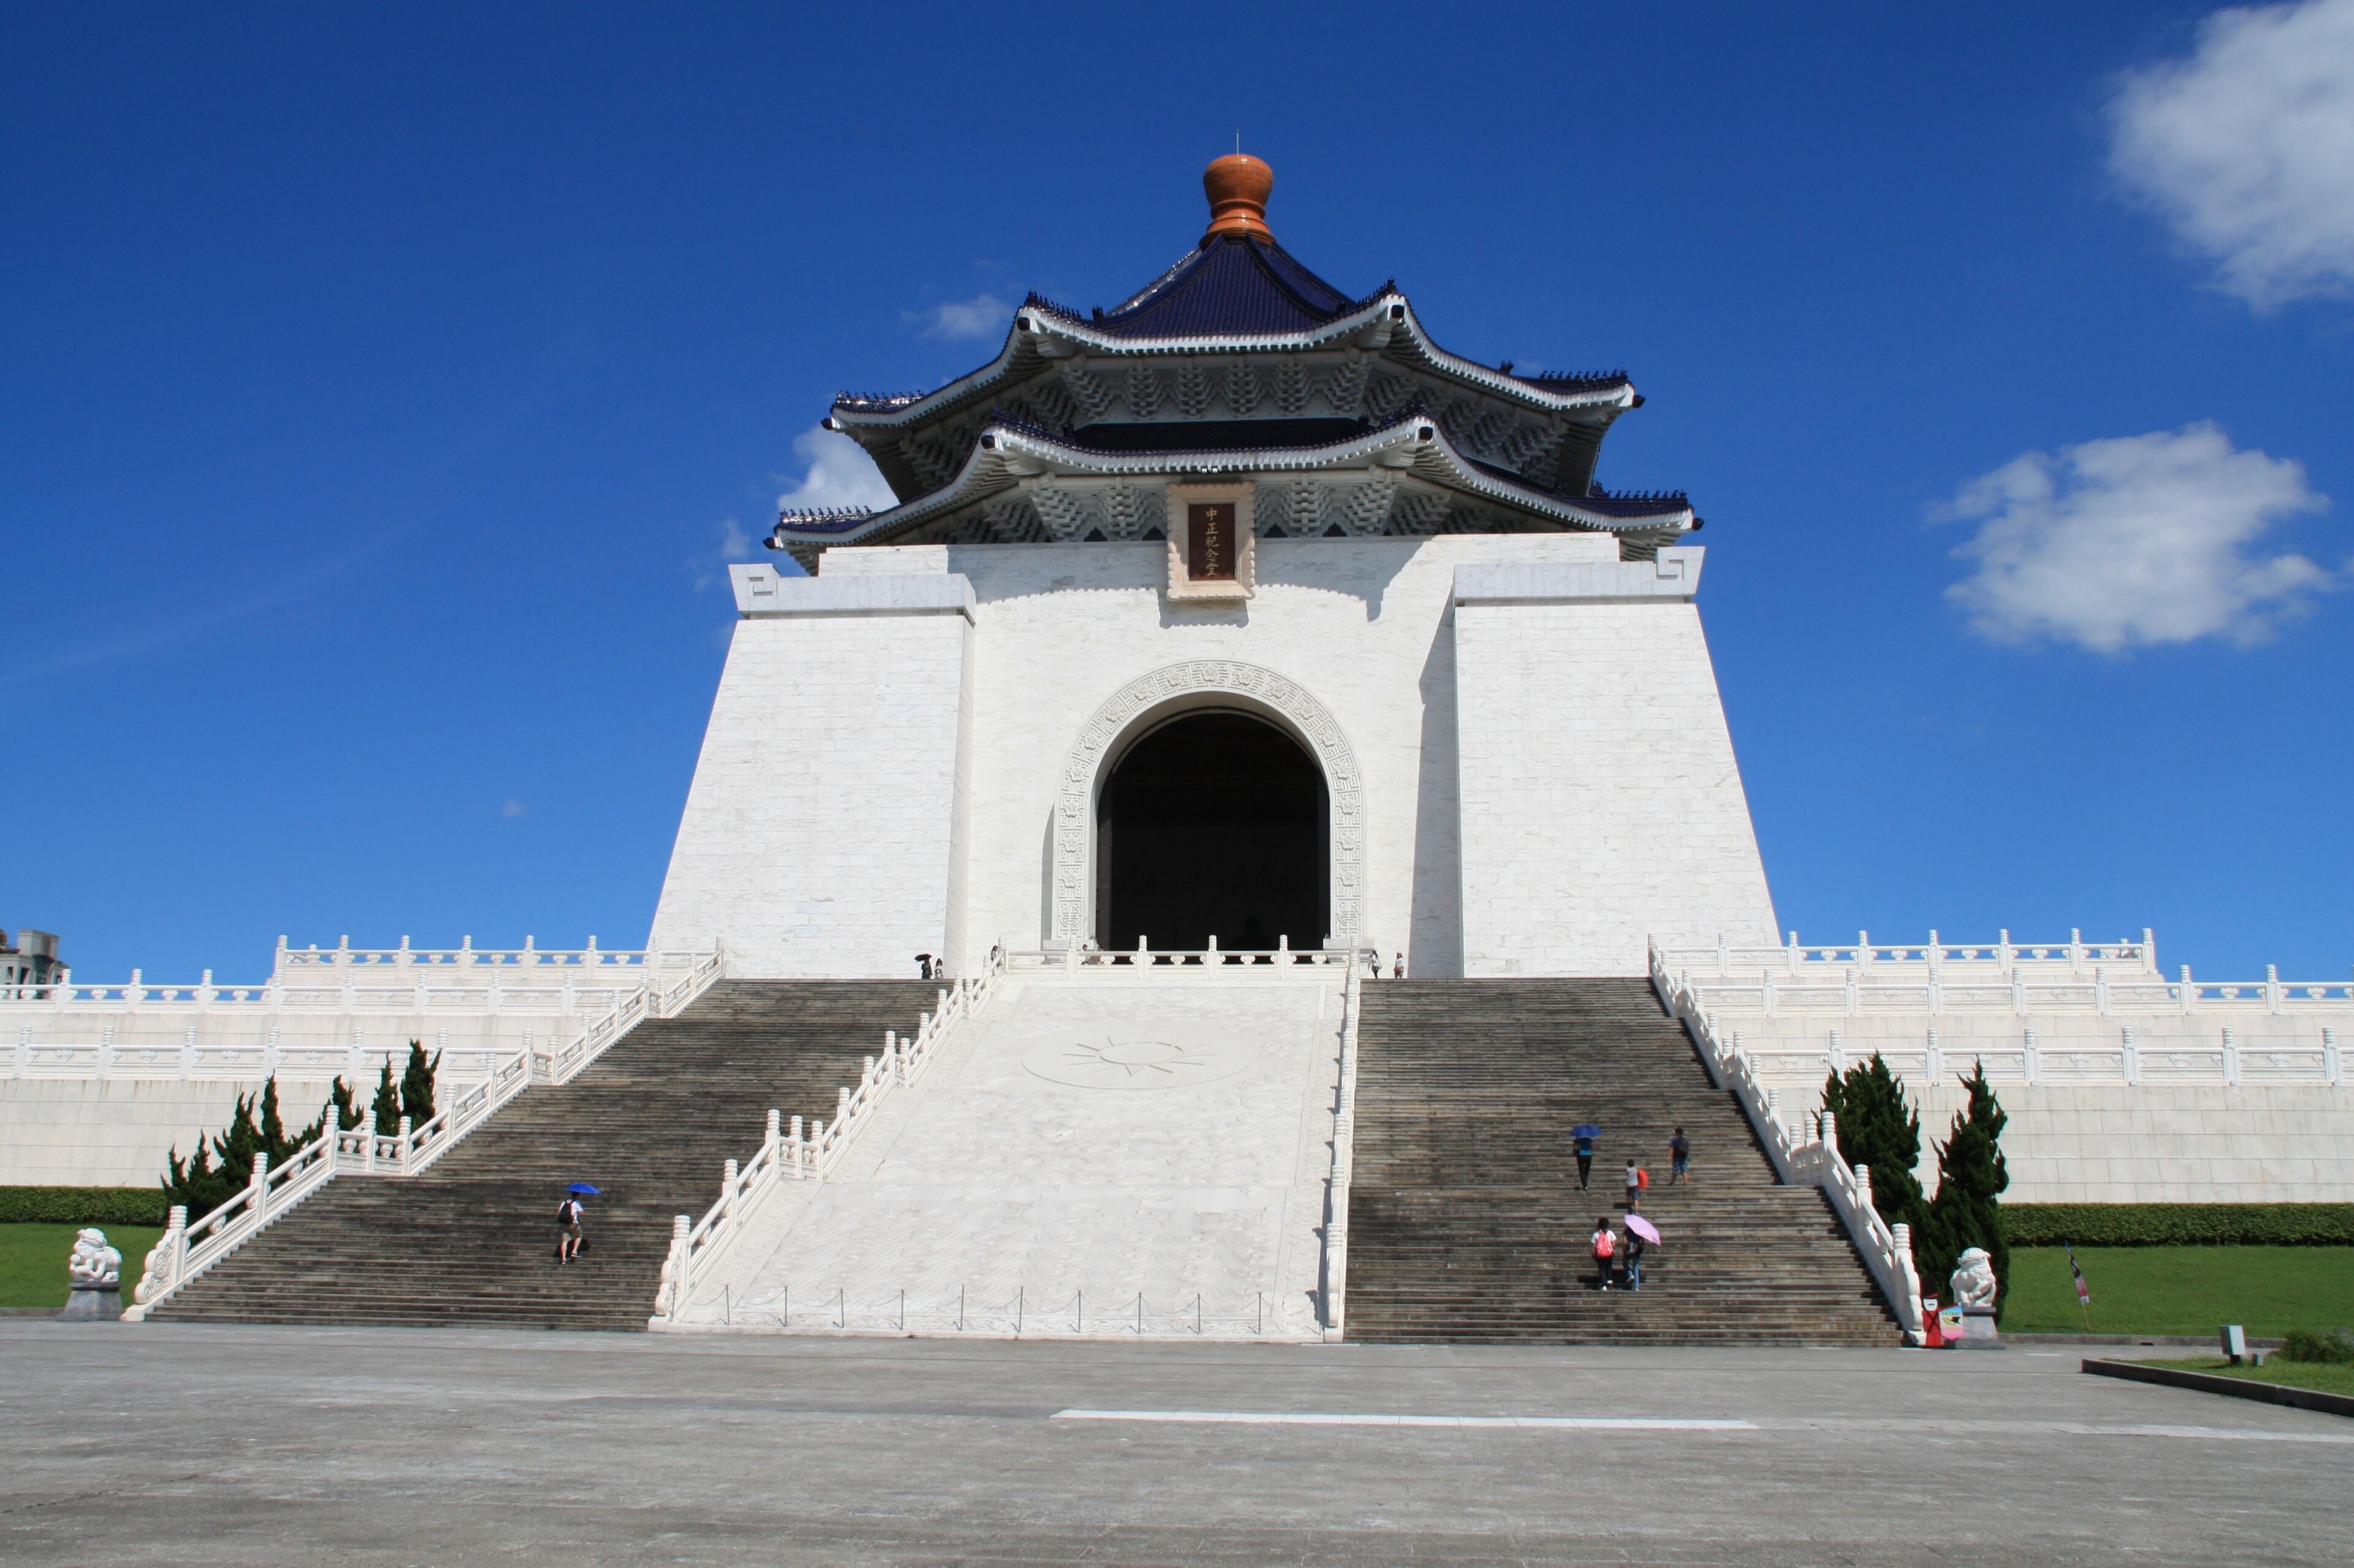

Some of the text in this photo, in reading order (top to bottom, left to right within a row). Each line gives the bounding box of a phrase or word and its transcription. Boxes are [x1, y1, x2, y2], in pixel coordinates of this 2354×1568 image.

[1205, 508, 1219, 576] 中正紀念堂
